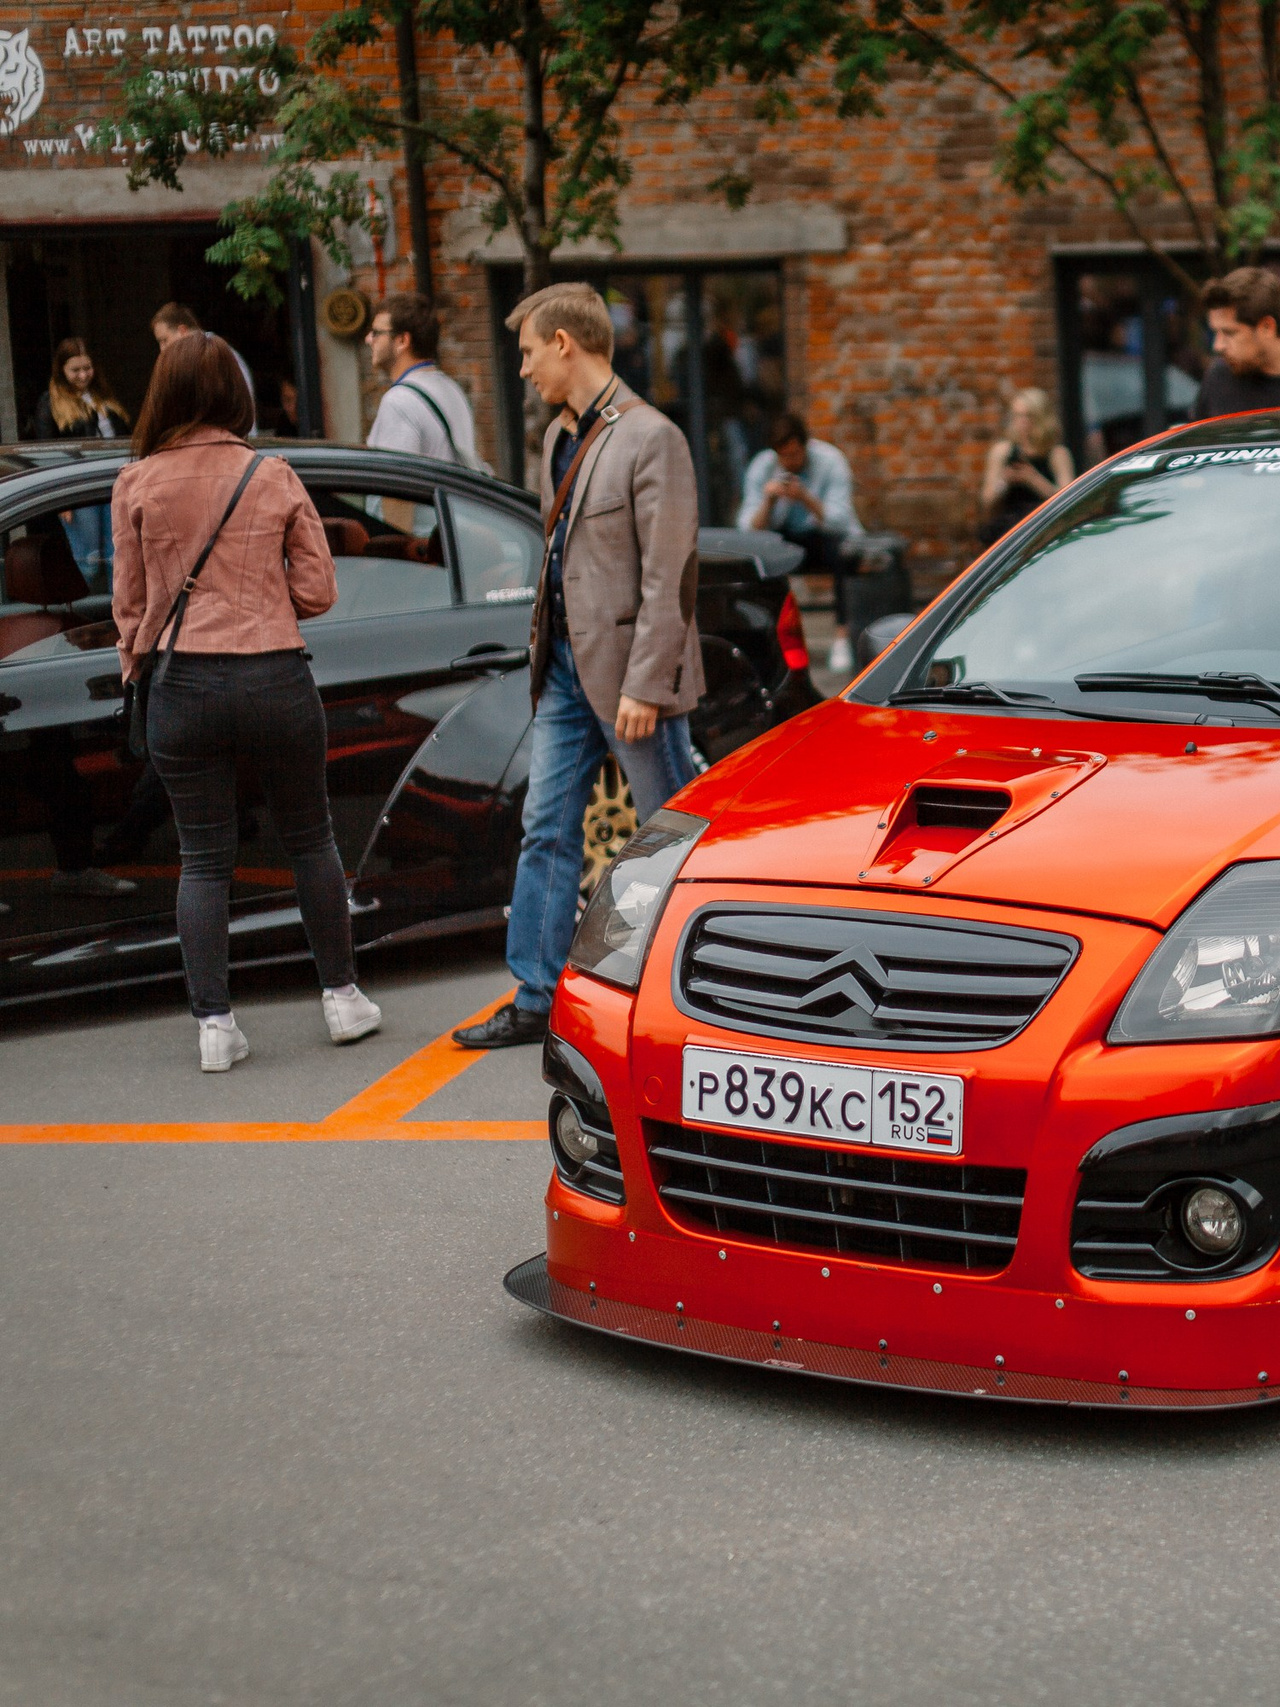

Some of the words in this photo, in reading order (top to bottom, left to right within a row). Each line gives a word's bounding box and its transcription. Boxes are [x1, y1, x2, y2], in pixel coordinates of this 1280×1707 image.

[63, 27, 127, 57] ART
[142, 24, 277, 56] TATTOO
[698, 1063, 867, 1132] Р839КС
[877, 1080, 946, 1127] 152
[891, 1124, 926, 1142] RUS
